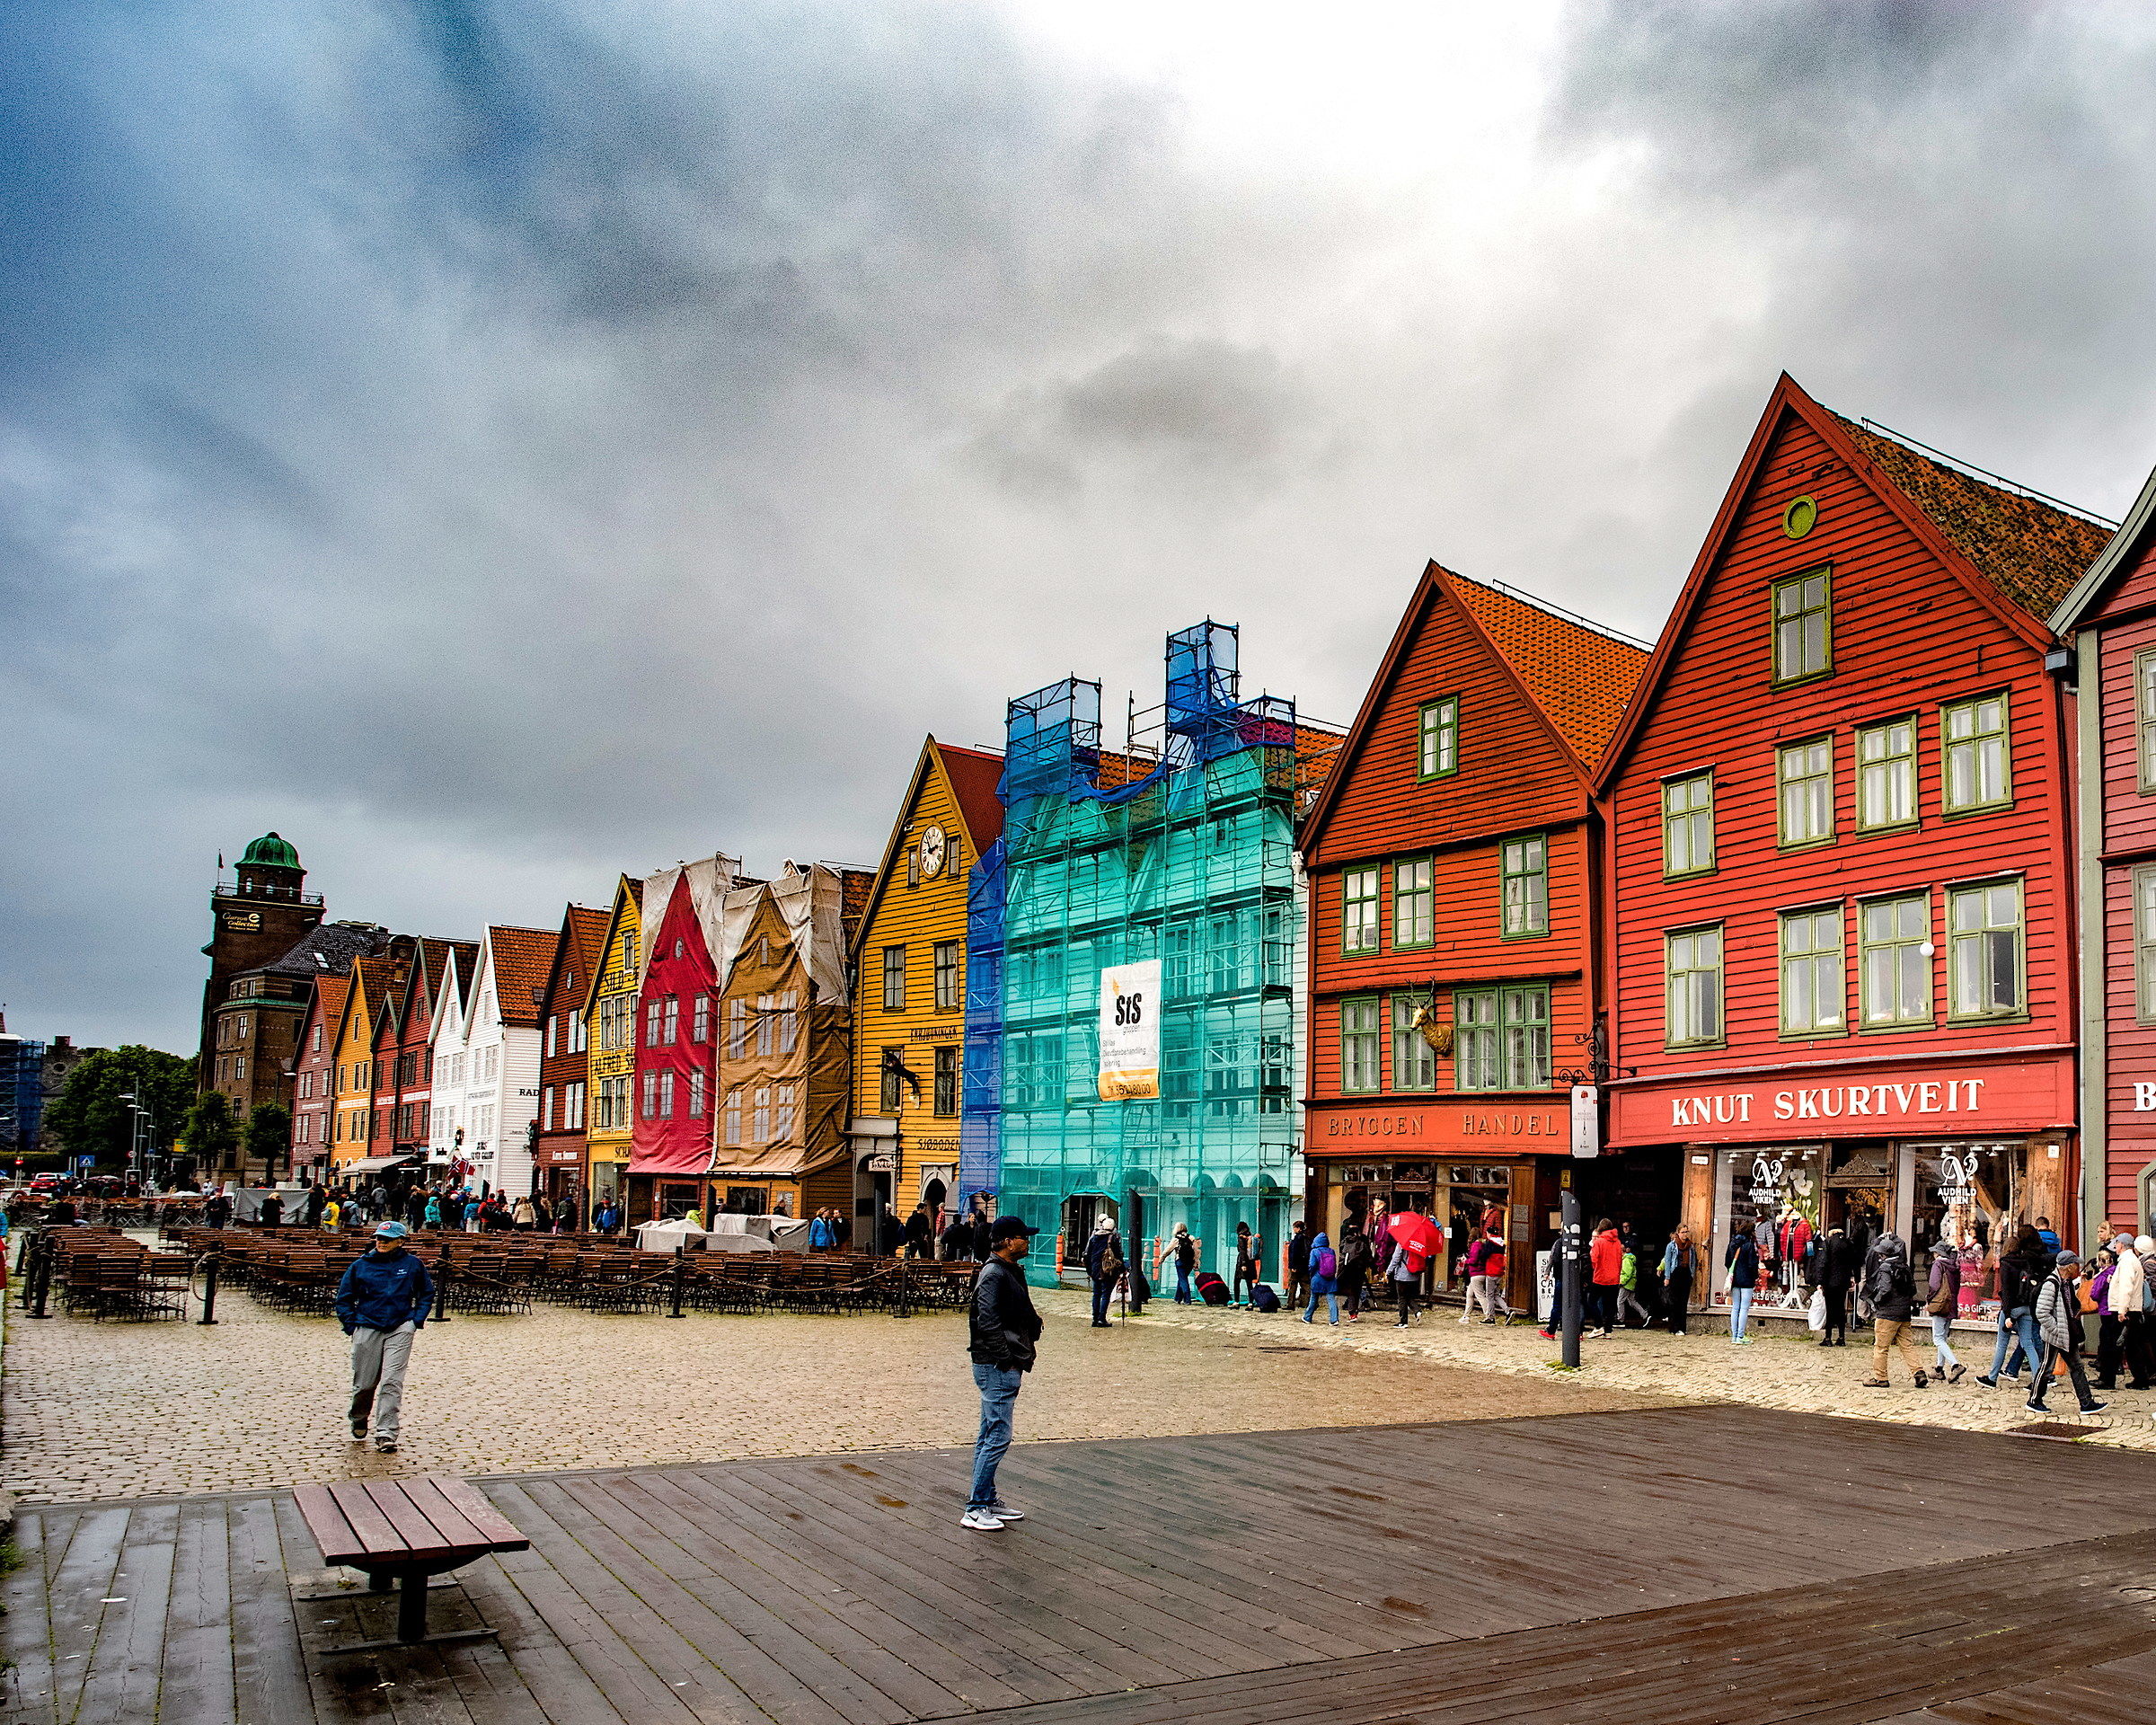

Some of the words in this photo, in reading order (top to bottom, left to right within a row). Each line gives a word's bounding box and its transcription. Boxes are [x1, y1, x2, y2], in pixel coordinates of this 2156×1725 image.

[227, 920, 261, 928] Collection
[1115, 993, 1142, 1026] StS
[1671, 1093, 1754, 1127] KNUT
[1773, 1078, 1986, 1120] SKURTVEIT
[1328, 1114, 1425, 1137] BRYGGEN
[1462, 1113, 1560, 1136] HANDEL
[1748, 1188, 1781, 1198] AUDHILD
[1937, 1187, 1977, 1197] AUDHILD
[1753, 1196, 1775, 1205] VIKEN
[1941, 1196, 1969, 1205] VIKEN
[1964, 1305, 1971, 1313] &
[1971, 1305, 1993, 1314] GIFTS
